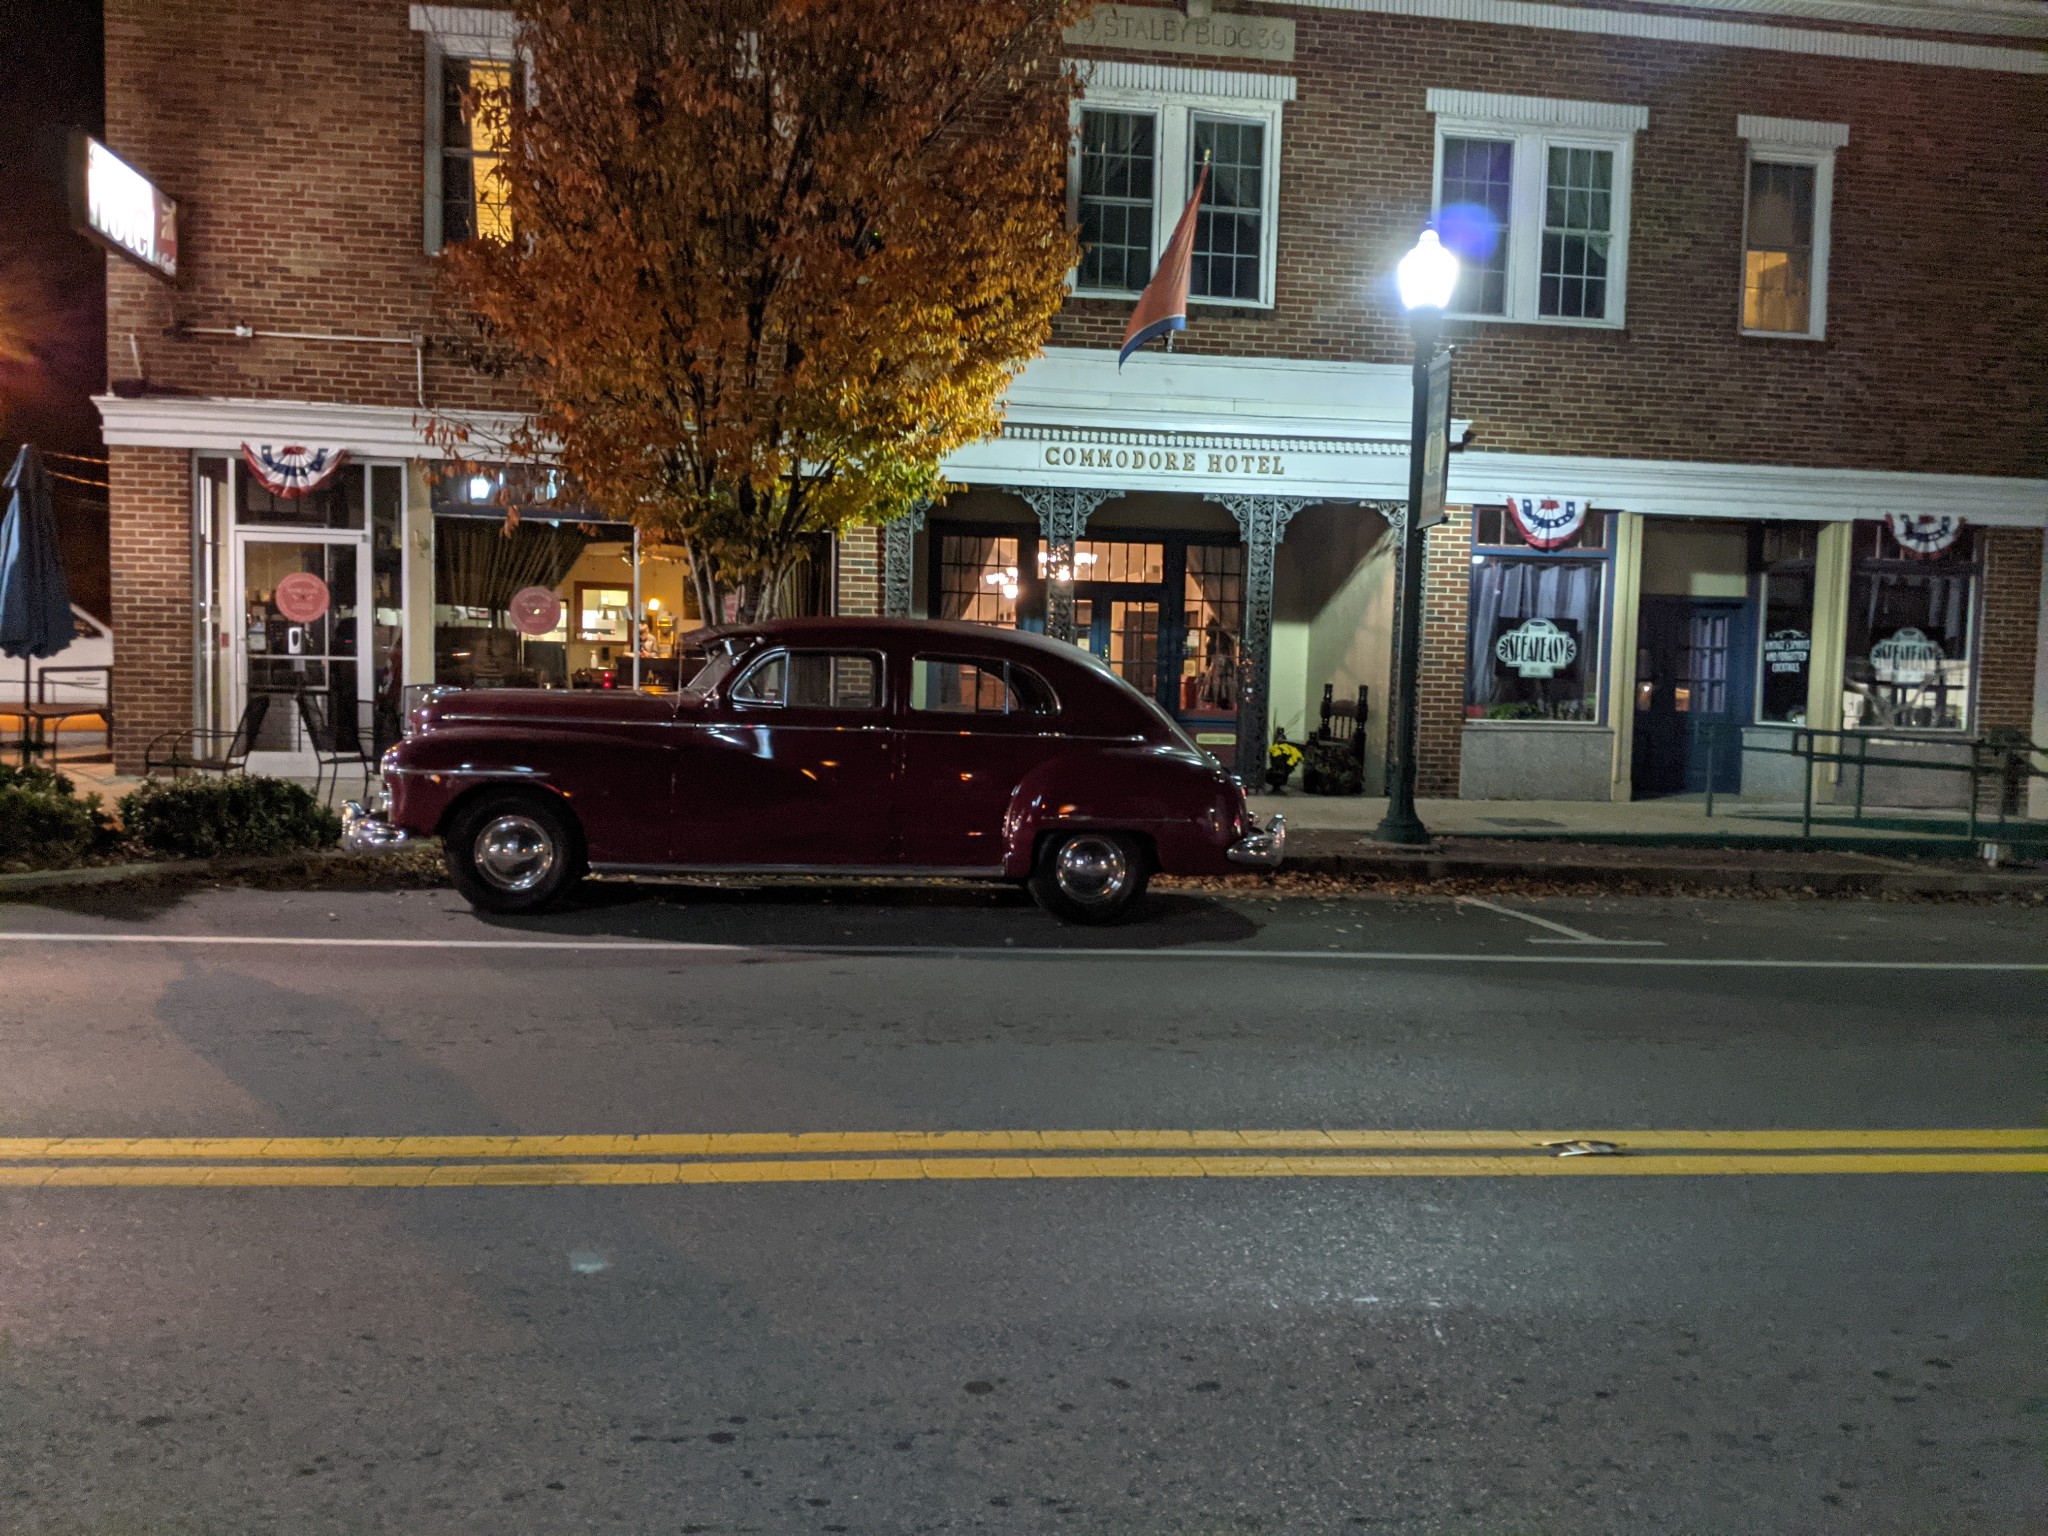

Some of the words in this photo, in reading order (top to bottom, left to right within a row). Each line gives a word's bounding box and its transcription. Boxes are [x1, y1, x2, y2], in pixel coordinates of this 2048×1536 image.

[1103, 16, 1190, 44] STALEY
[1196, 24, 1252, 48] BLDG
[1255, 27, 1286, 51] 39
[1045, 446, 1196, 472] COMMODORE
[1207, 453, 1285, 475] HOTEL
[1508, 634, 1566, 663] SPEAKEASY
